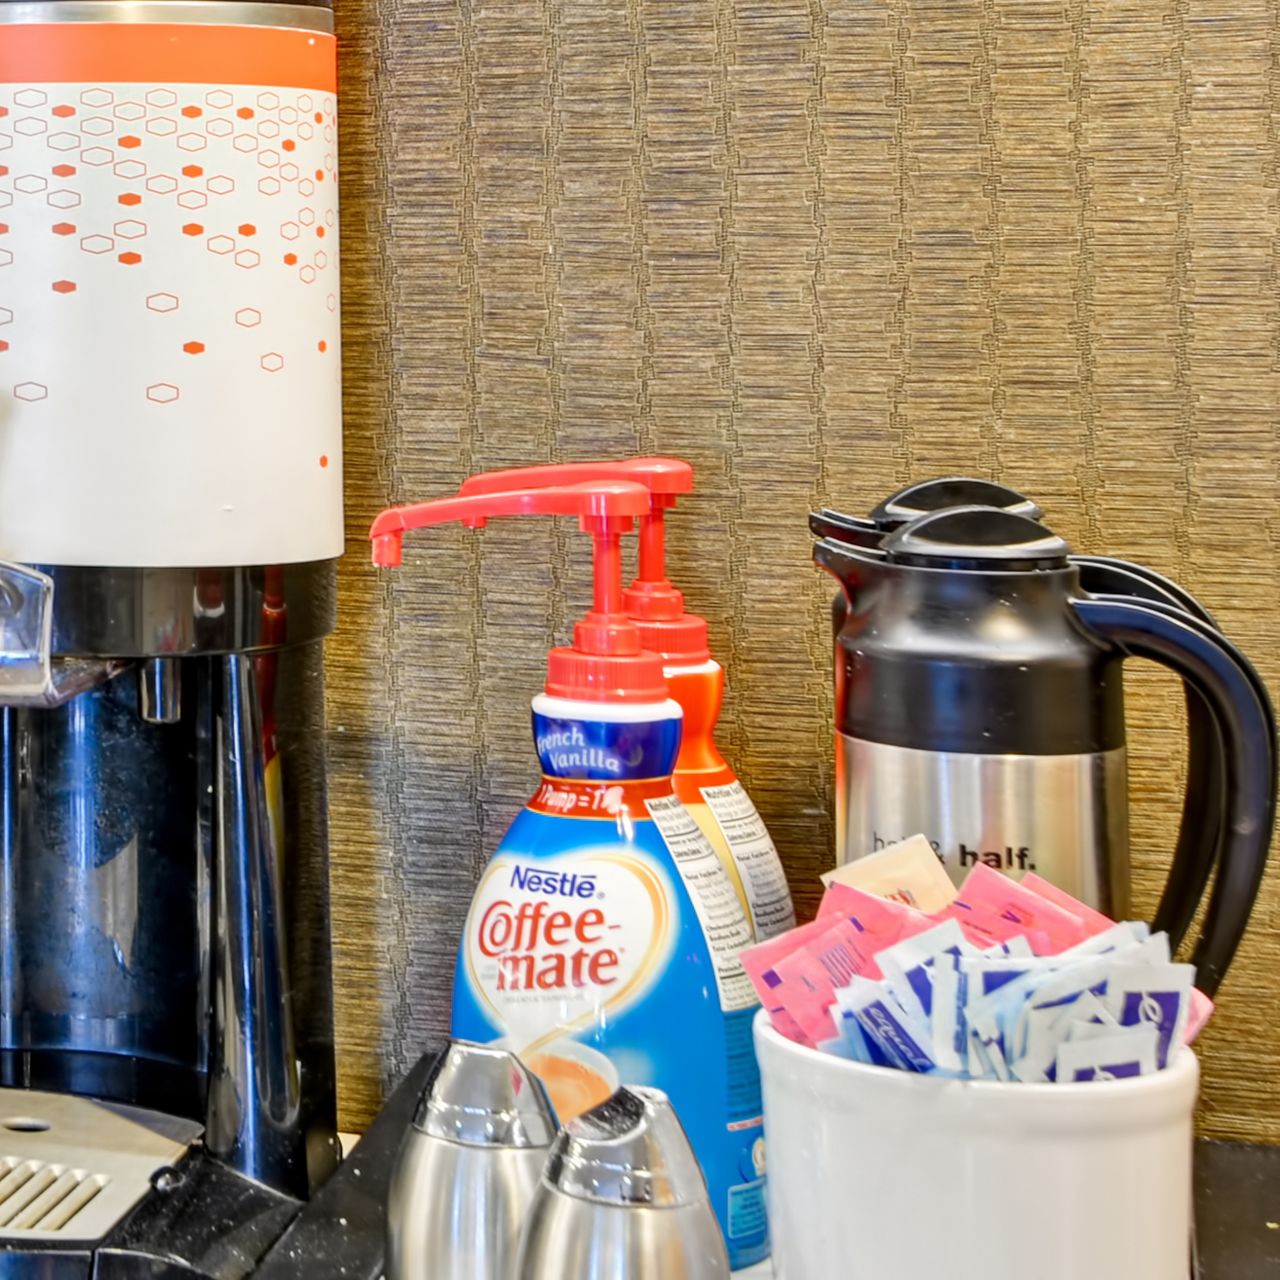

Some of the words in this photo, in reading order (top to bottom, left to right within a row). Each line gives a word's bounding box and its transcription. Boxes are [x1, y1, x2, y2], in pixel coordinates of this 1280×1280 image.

[549, 748, 621, 773] Vanilla
[959, 843, 1037, 871] half.
[509, 864, 598, 900] Nestlé
[496, 946, 620, 993] mate
